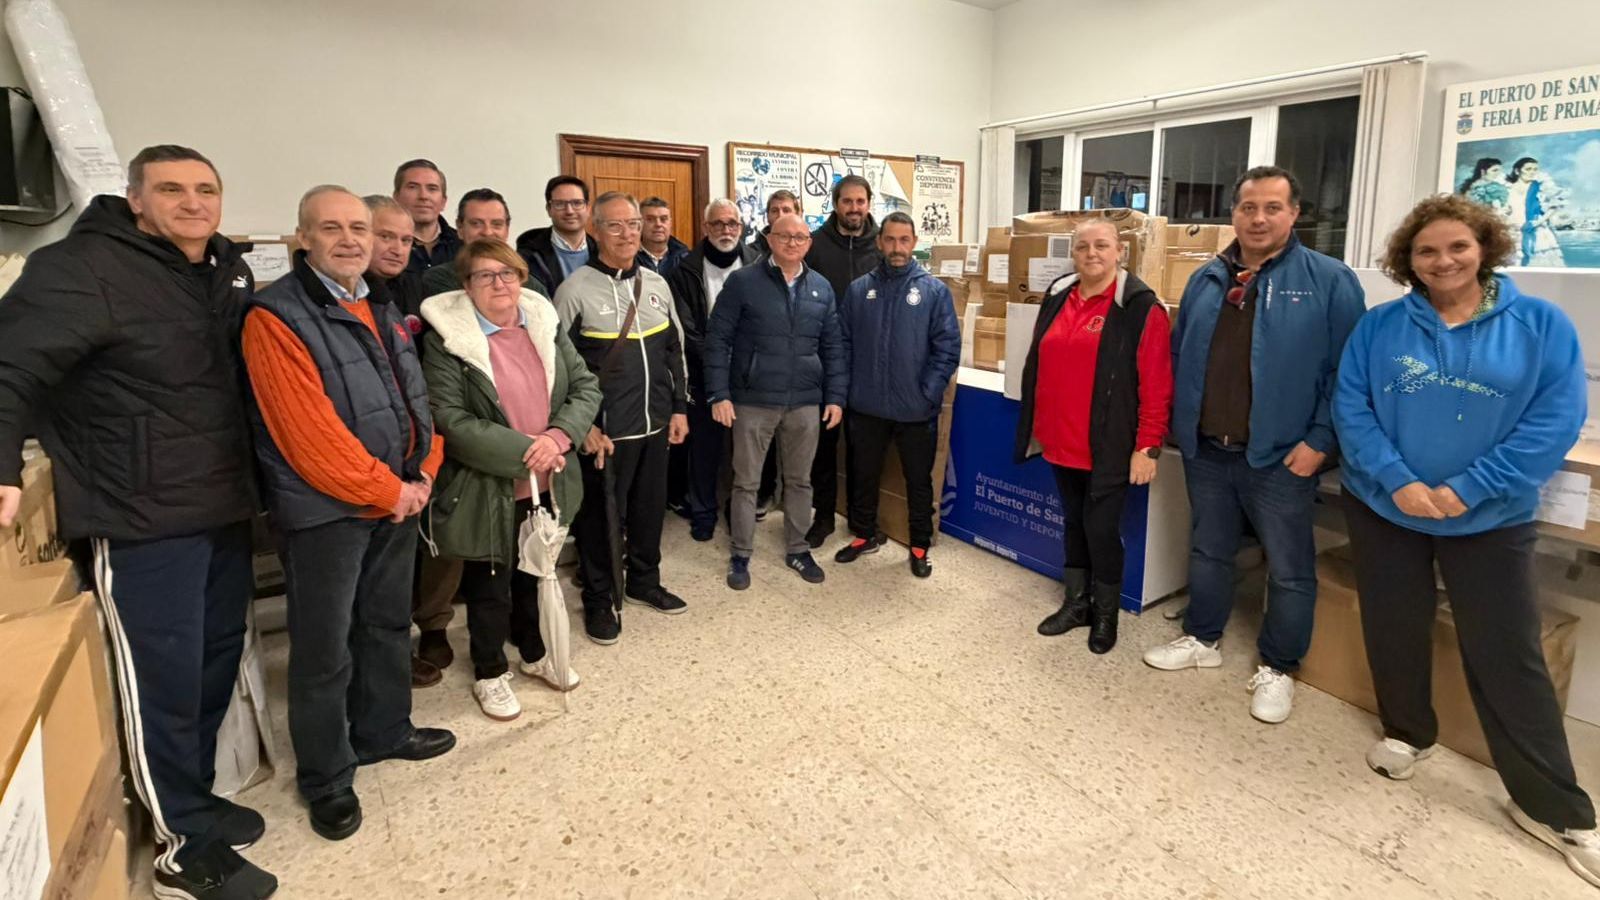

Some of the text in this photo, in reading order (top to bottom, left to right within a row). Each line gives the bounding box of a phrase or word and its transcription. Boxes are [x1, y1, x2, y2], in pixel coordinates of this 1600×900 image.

[1458, 75, 1600, 108] EL PUERTO DE SAN
[1482, 107, 1522, 127] FERIA
[1528, 104, 1549, 123] DE
[736, 150, 797, 160] RECORRIDO MUNICIPAL
[915, 175, 956, 184] CONVIVENCIA
[919, 182, 953, 190] DEPORTIVA
[975, 471, 1059, 507] Ayuntamiento de
[975, 484, 985, 497] El
[987, 488, 1024, 511] Puerto
[1026, 502, 1041, 517] de
[974, 500, 1019, 524] JUVENTUD
[1021, 517, 1028, 528] Y
